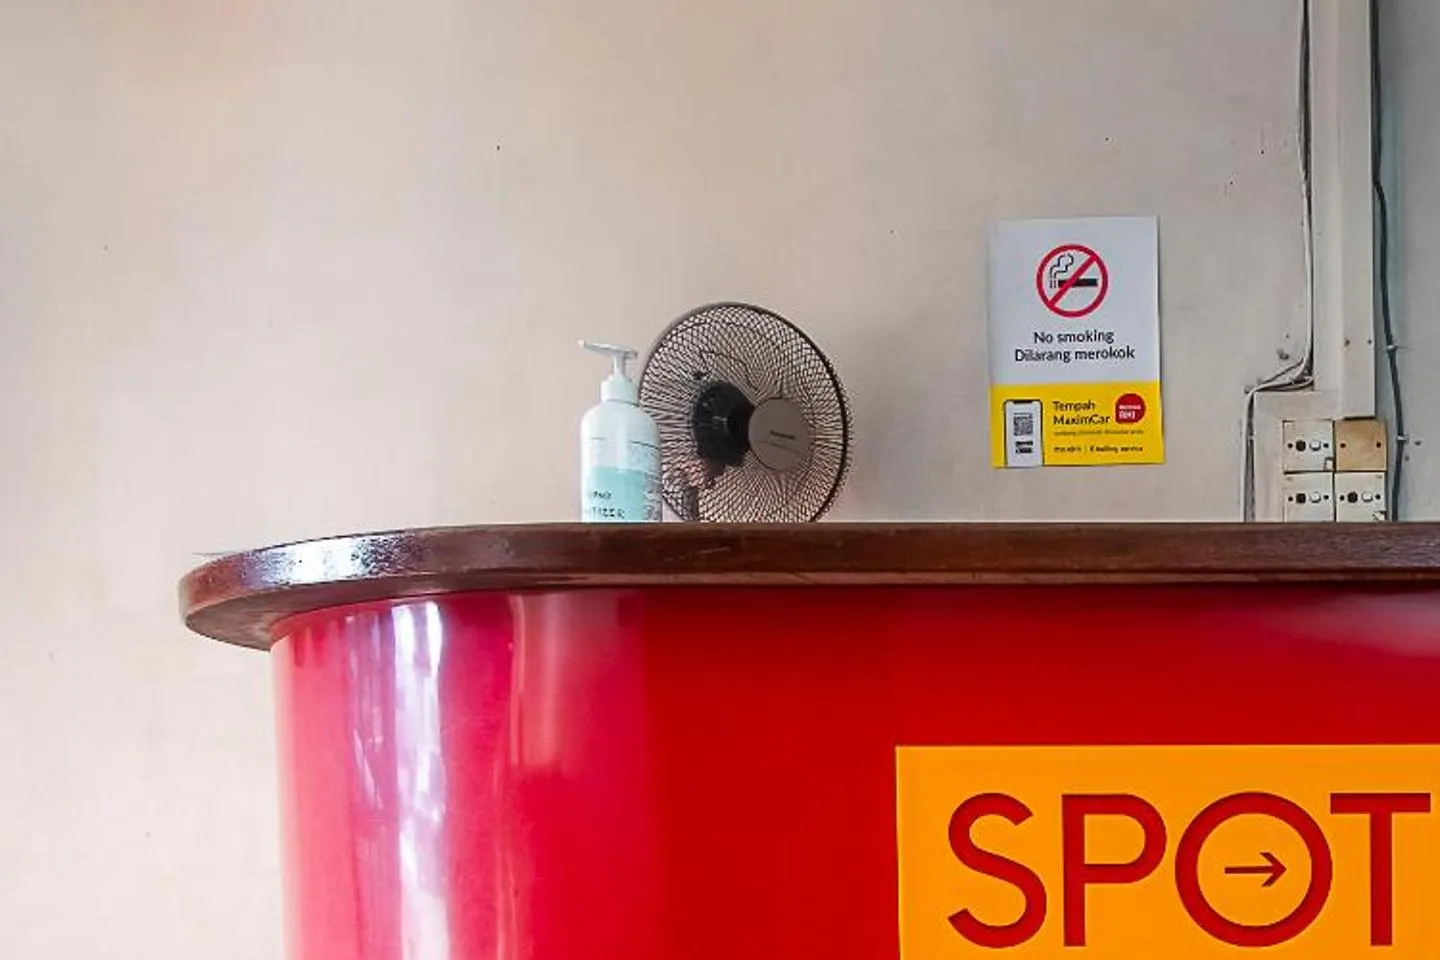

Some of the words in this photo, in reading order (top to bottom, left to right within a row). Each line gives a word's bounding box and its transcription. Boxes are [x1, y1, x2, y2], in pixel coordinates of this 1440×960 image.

[1033, 331, 1053, 344] No
[1057, 329, 1115, 344] smoking
[1014, 348, 1071, 363] Dilarang
[1074, 345, 1136, 360] merokok
[1052, 400, 1096, 412] Tempah
[1053, 414, 1111, 425] MaximCar
[947, 790, 1431, 949] SPOT
